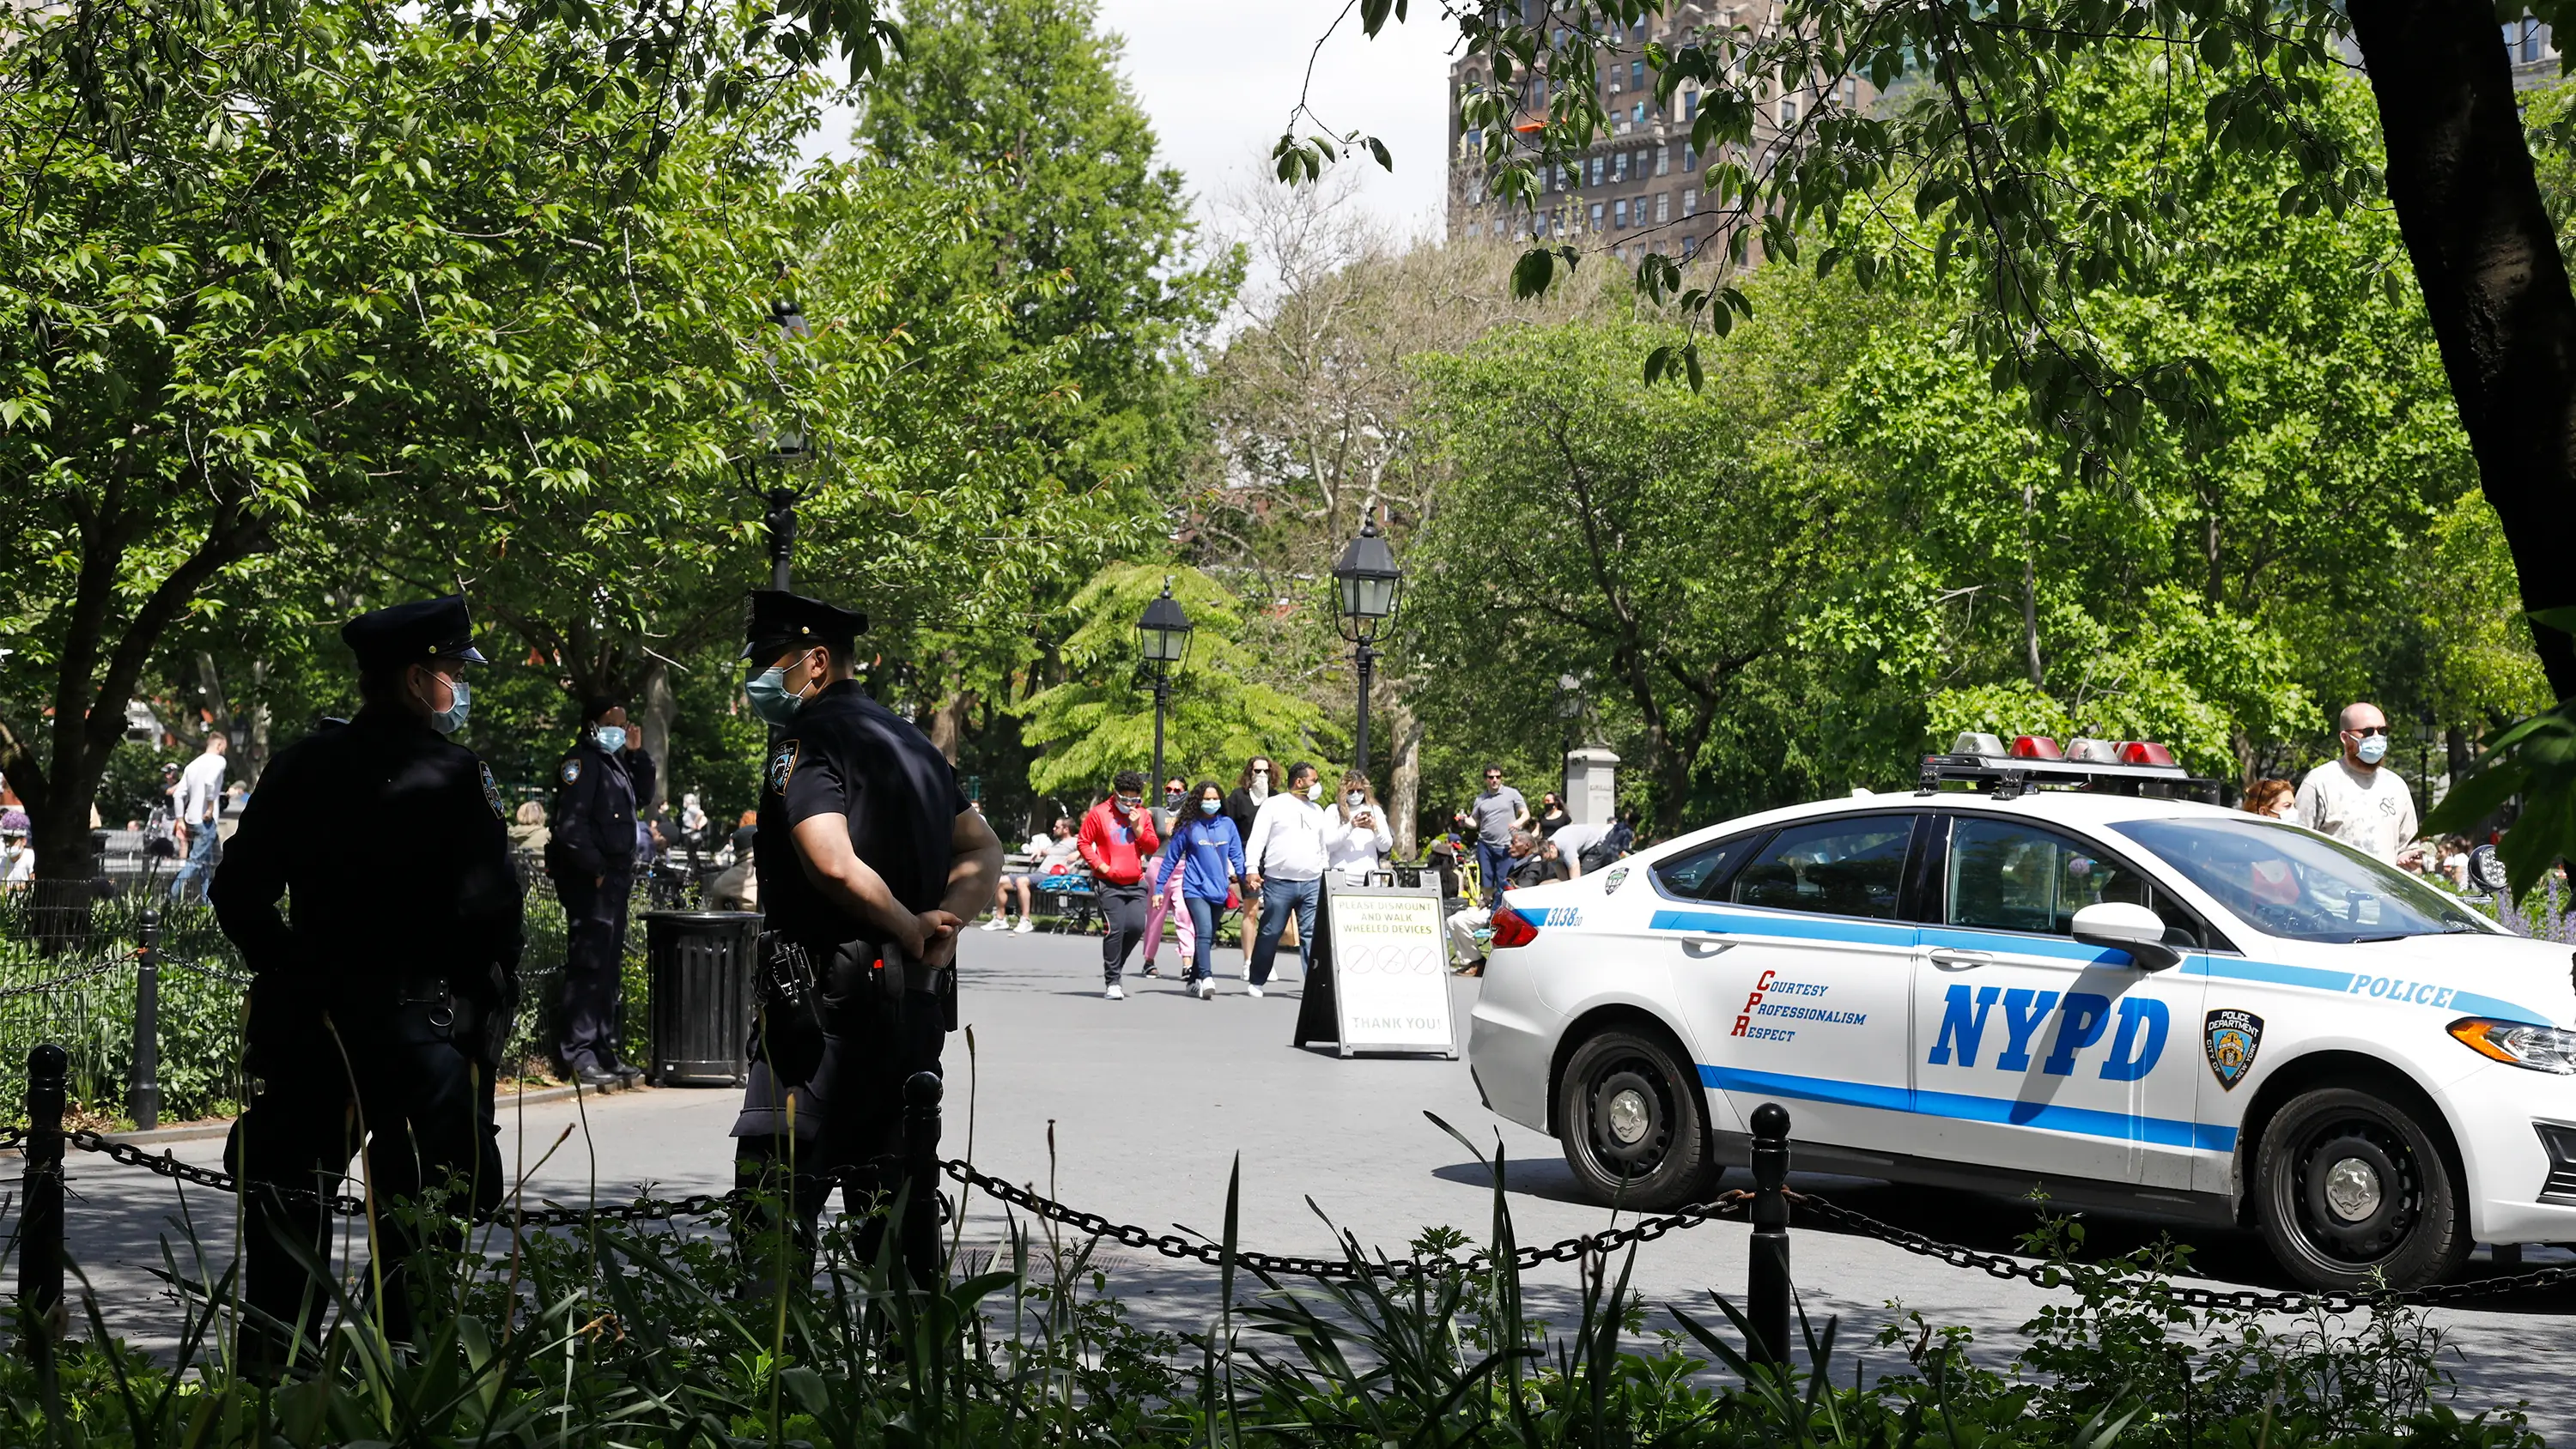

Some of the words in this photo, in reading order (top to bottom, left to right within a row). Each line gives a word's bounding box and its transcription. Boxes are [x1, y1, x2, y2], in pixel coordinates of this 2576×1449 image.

[1339, 900, 1375, 911] PLEASE
[1377, 901, 1431, 912] DISMOUNT
[1361, 912, 1382, 922] AND
[1384, 912, 1413, 923] WALK
[1547, 906, 1578, 927] 3138
[1343, 924, 1389, 934] WHEELED
[1392, 925, 1432, 935] DEVICES
[2350, 974, 2454, 1009] POLICE
[1352, 1016, 1402, 1029] THANK
[1406, 1017, 1442, 1030] YOU!
[2221, 1011, 2251, 1023] POLICE
[1927, 983, 2171, 1082] NYPD
[2208, 1019, 2259, 1037] DEPARTMENT
[2206, 1039, 2215, 1059] CITY
[2212, 1061, 2221, 1073] OF
[2235, 1063, 2249, 1080] NEW
[2245, 1043, 2257, 1062] YORK
